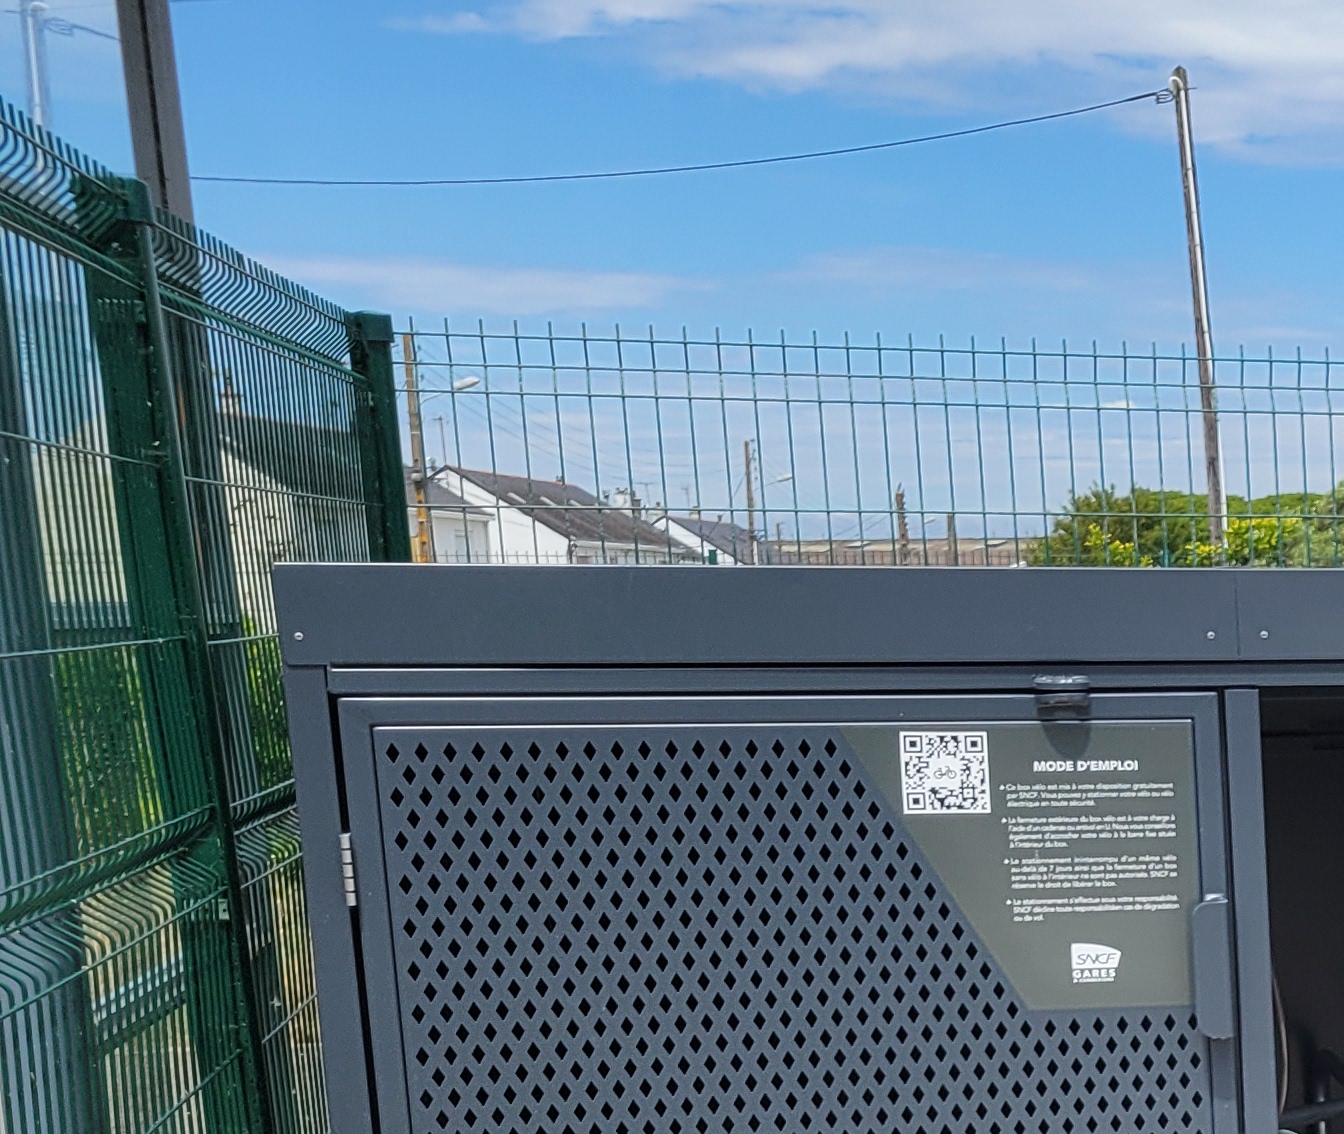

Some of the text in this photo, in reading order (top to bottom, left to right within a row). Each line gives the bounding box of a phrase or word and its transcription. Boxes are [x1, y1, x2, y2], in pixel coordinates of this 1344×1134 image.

[1033, 760, 1074, 772] MODE
[1075, 952, 1118, 966] SNCF
[1072, 968, 1117, 978] GARES
